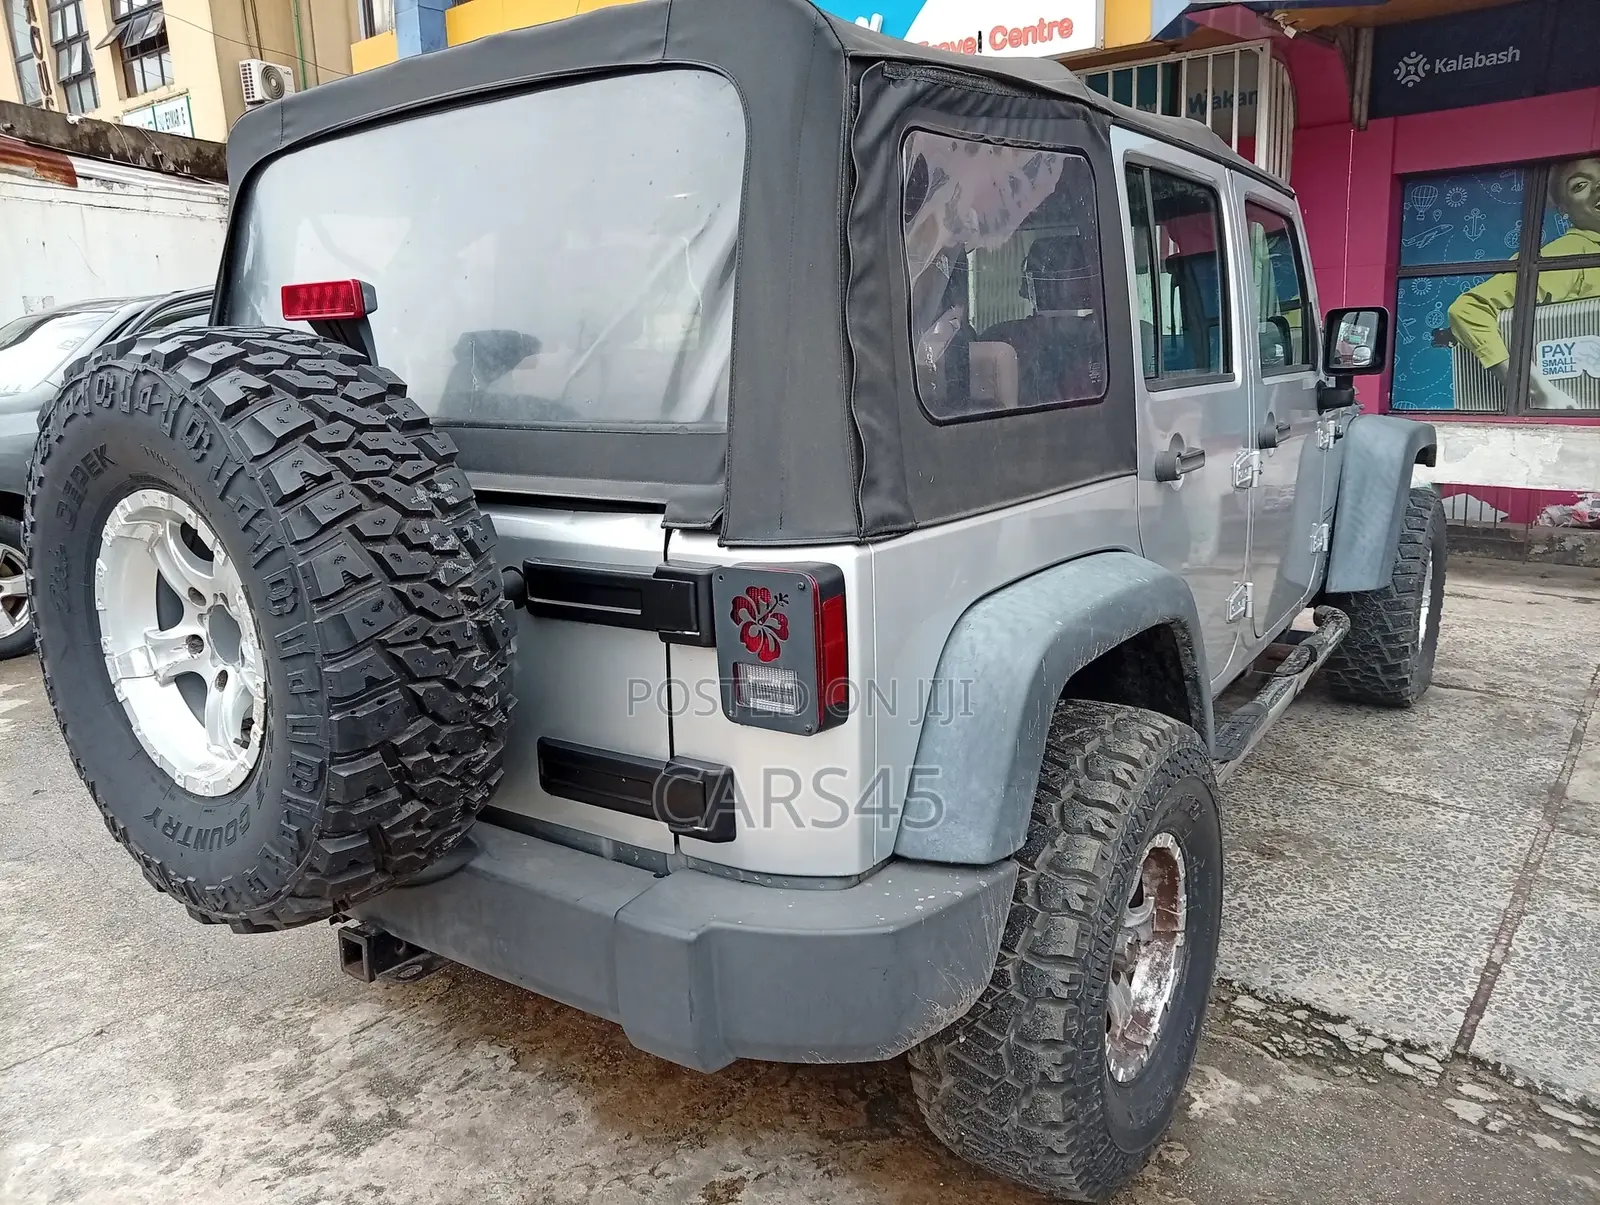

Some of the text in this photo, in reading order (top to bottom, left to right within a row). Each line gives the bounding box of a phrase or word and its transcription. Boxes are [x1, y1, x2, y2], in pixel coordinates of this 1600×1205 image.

[989, 17, 1074, 51] Centre
[1434, 45, 1521, 74] Kalabash
[1541, 341, 1576, 359] PAY
[1541, 357, 1576, 368] SMALL
[1542, 365, 1577, 376] SMALL
[142, 802, 250, 853] COUNTRY
